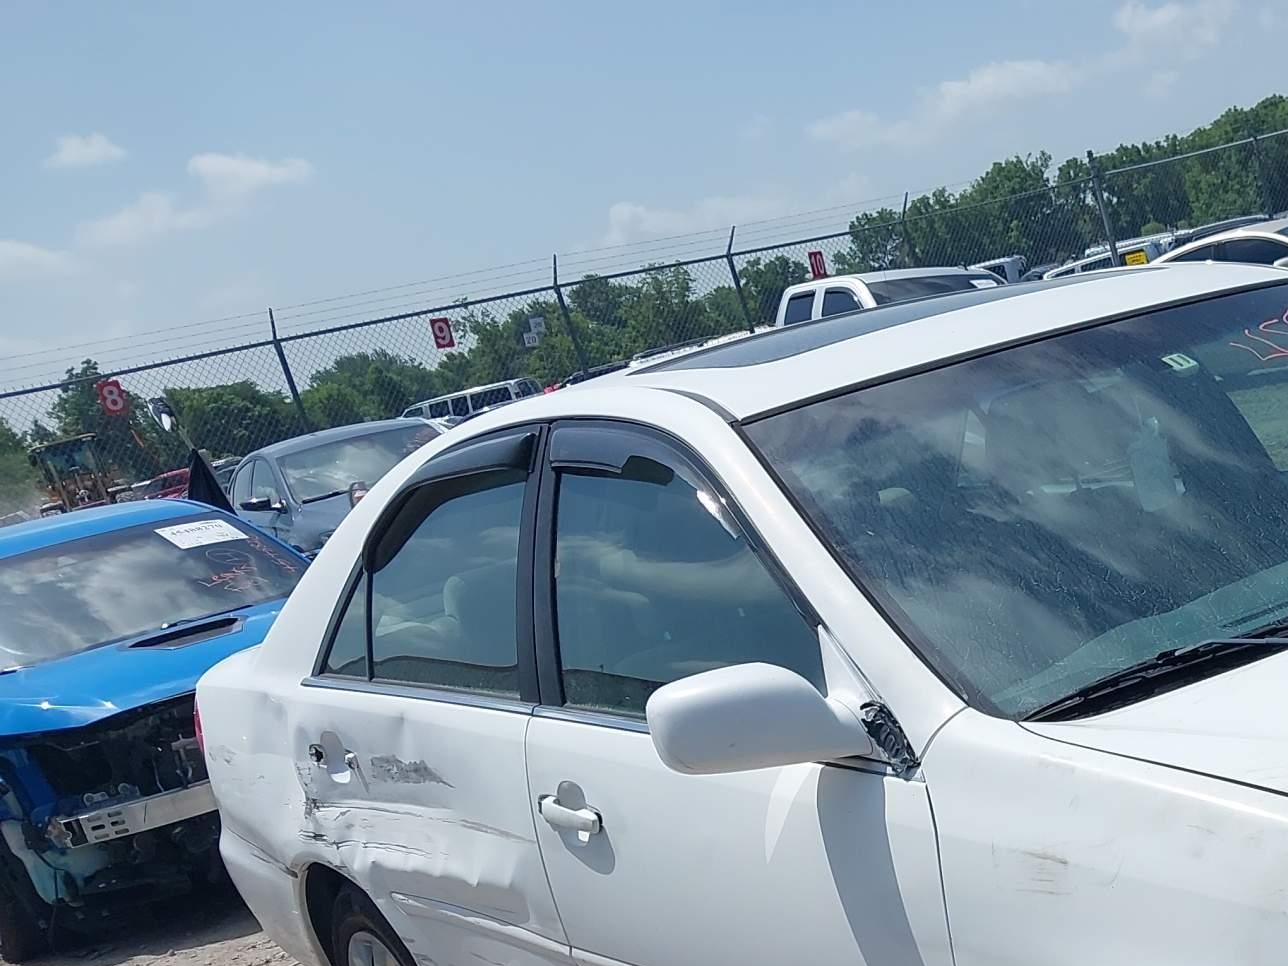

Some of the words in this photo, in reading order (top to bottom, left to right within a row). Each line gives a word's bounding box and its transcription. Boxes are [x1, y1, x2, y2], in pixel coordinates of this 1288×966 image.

[811, 253, 825, 275] 10
[433, 321, 451, 345] 9
[102, 385, 124, 411] 8
